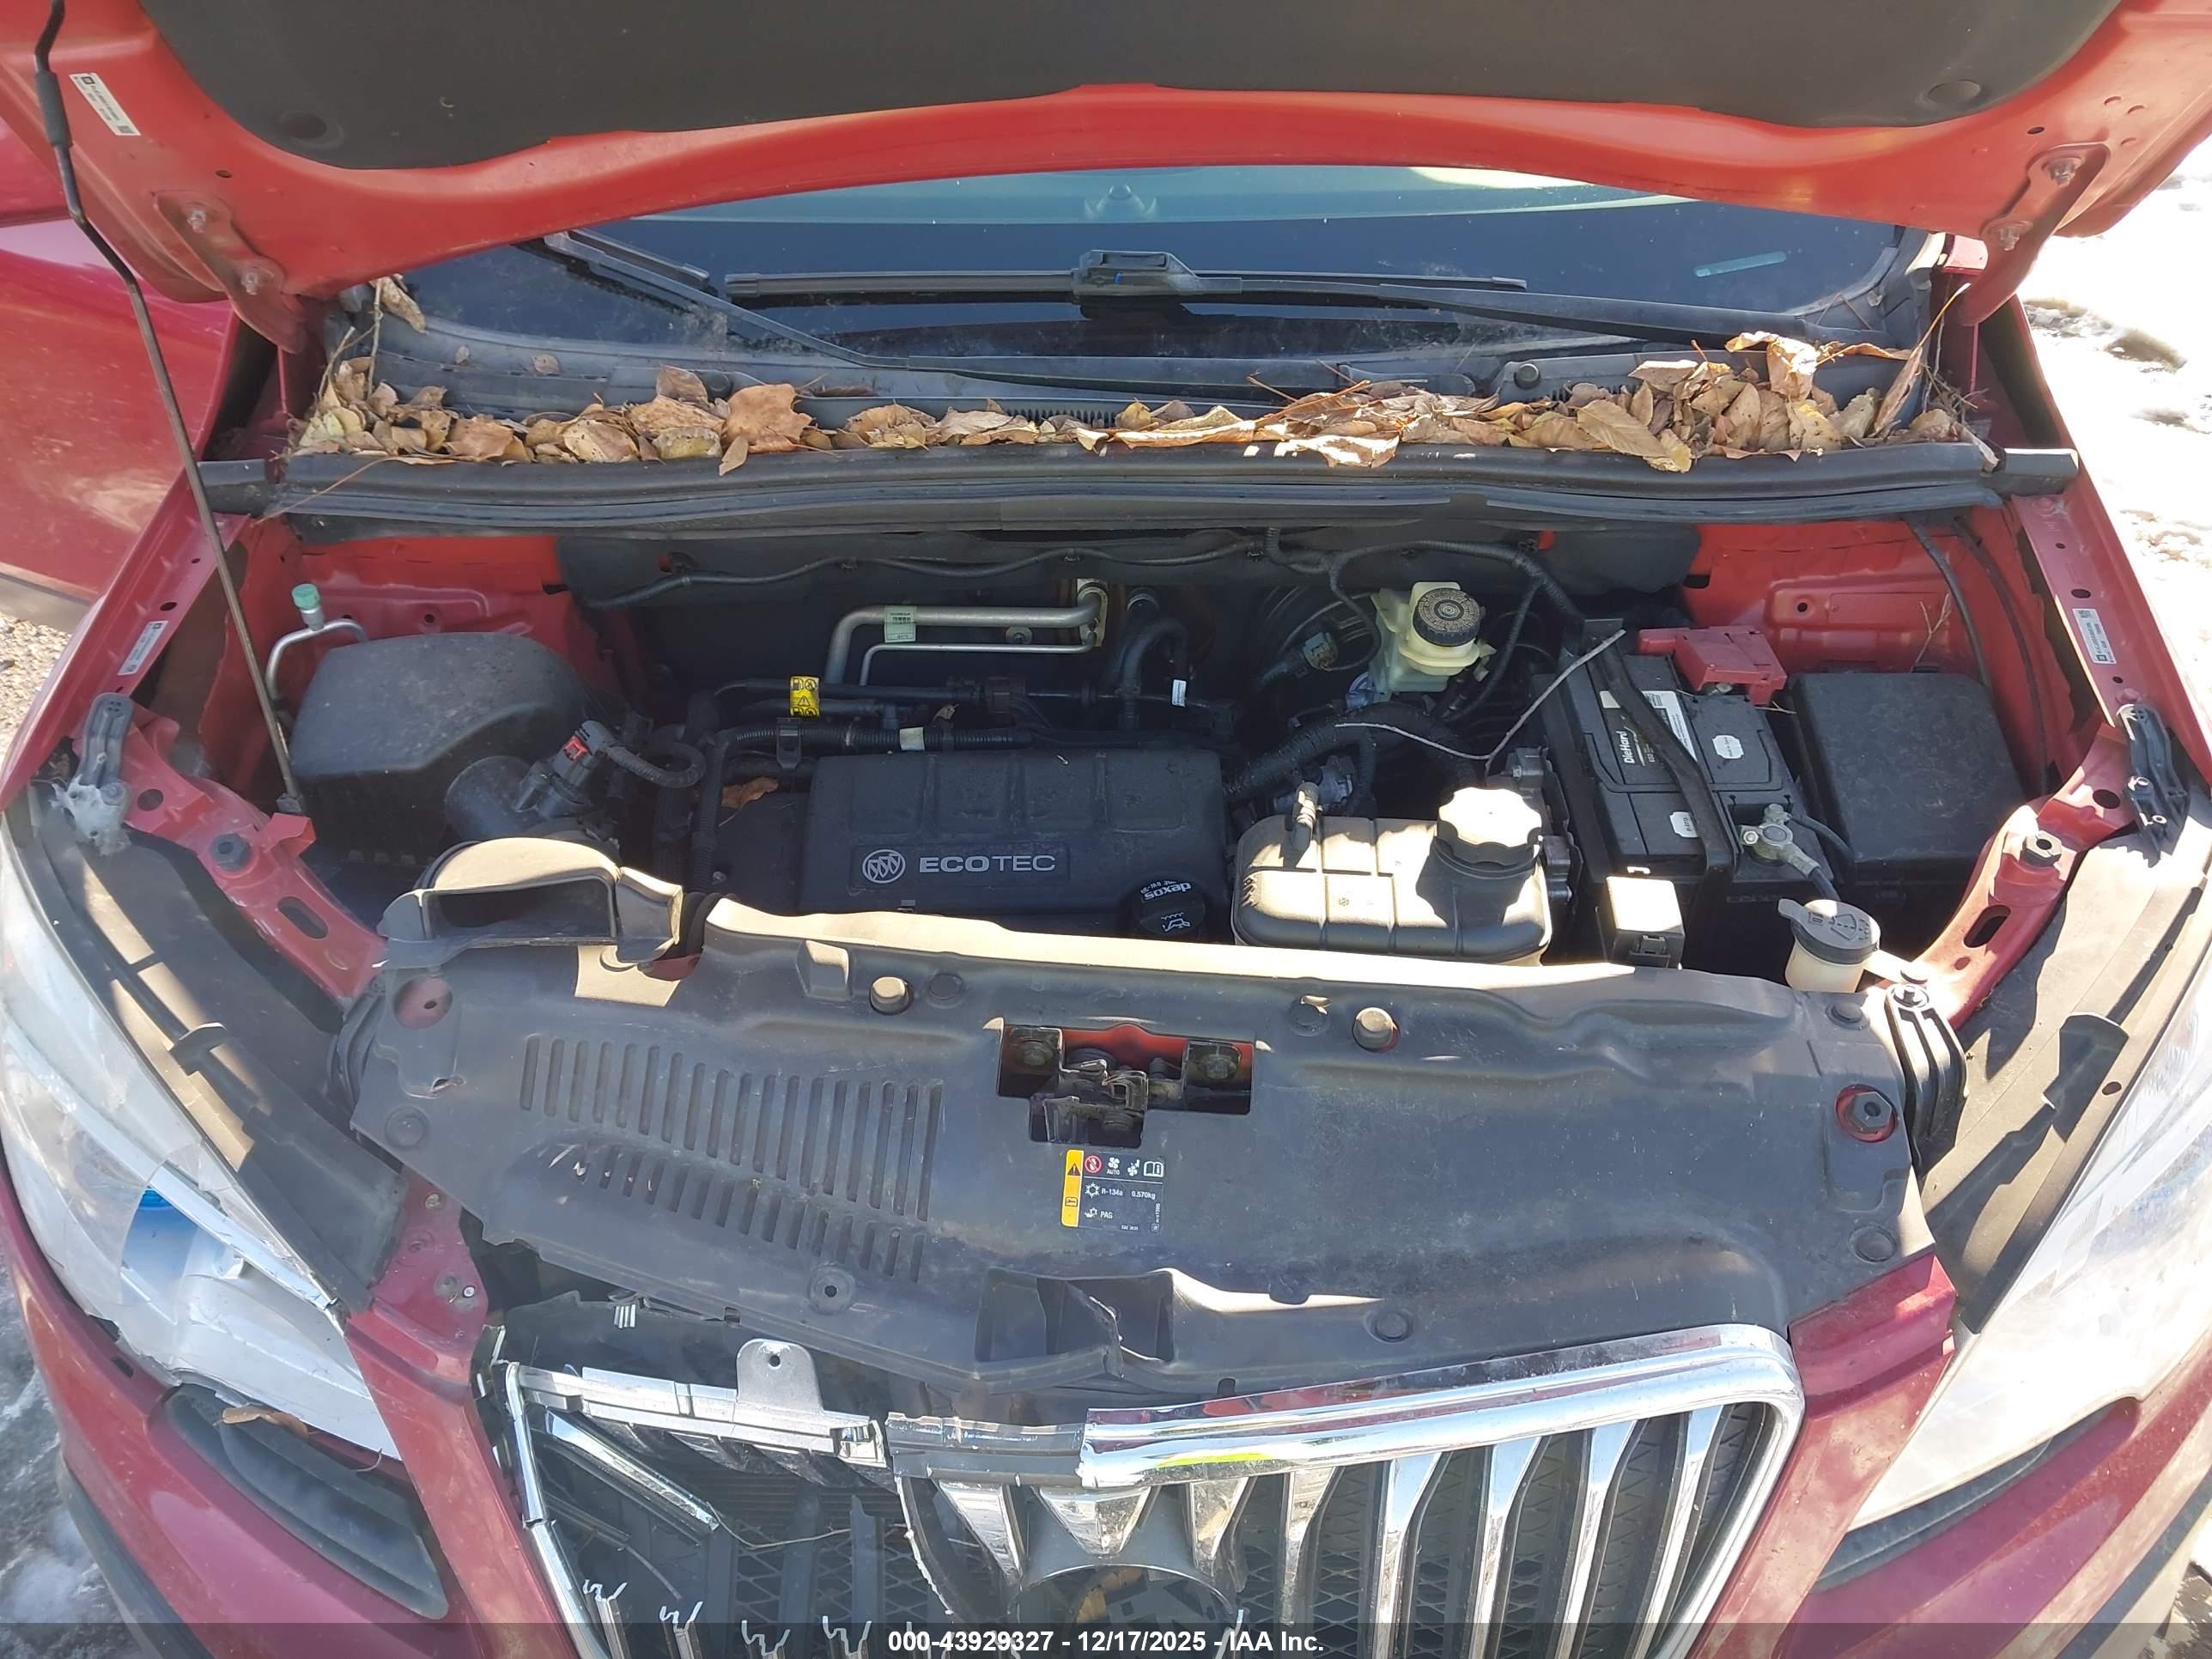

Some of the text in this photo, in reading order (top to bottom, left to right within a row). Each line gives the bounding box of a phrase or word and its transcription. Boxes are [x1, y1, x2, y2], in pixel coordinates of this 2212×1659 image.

[1615, 730, 1636, 763] DieHard
[919, 854, 1056, 873] ECOTEC
[1144, 882, 1192, 901] dexos
[1101, 1188, 1156, 1200] R-134a 0.570kg
[1100, 1211, 1114, 1219] PAG
